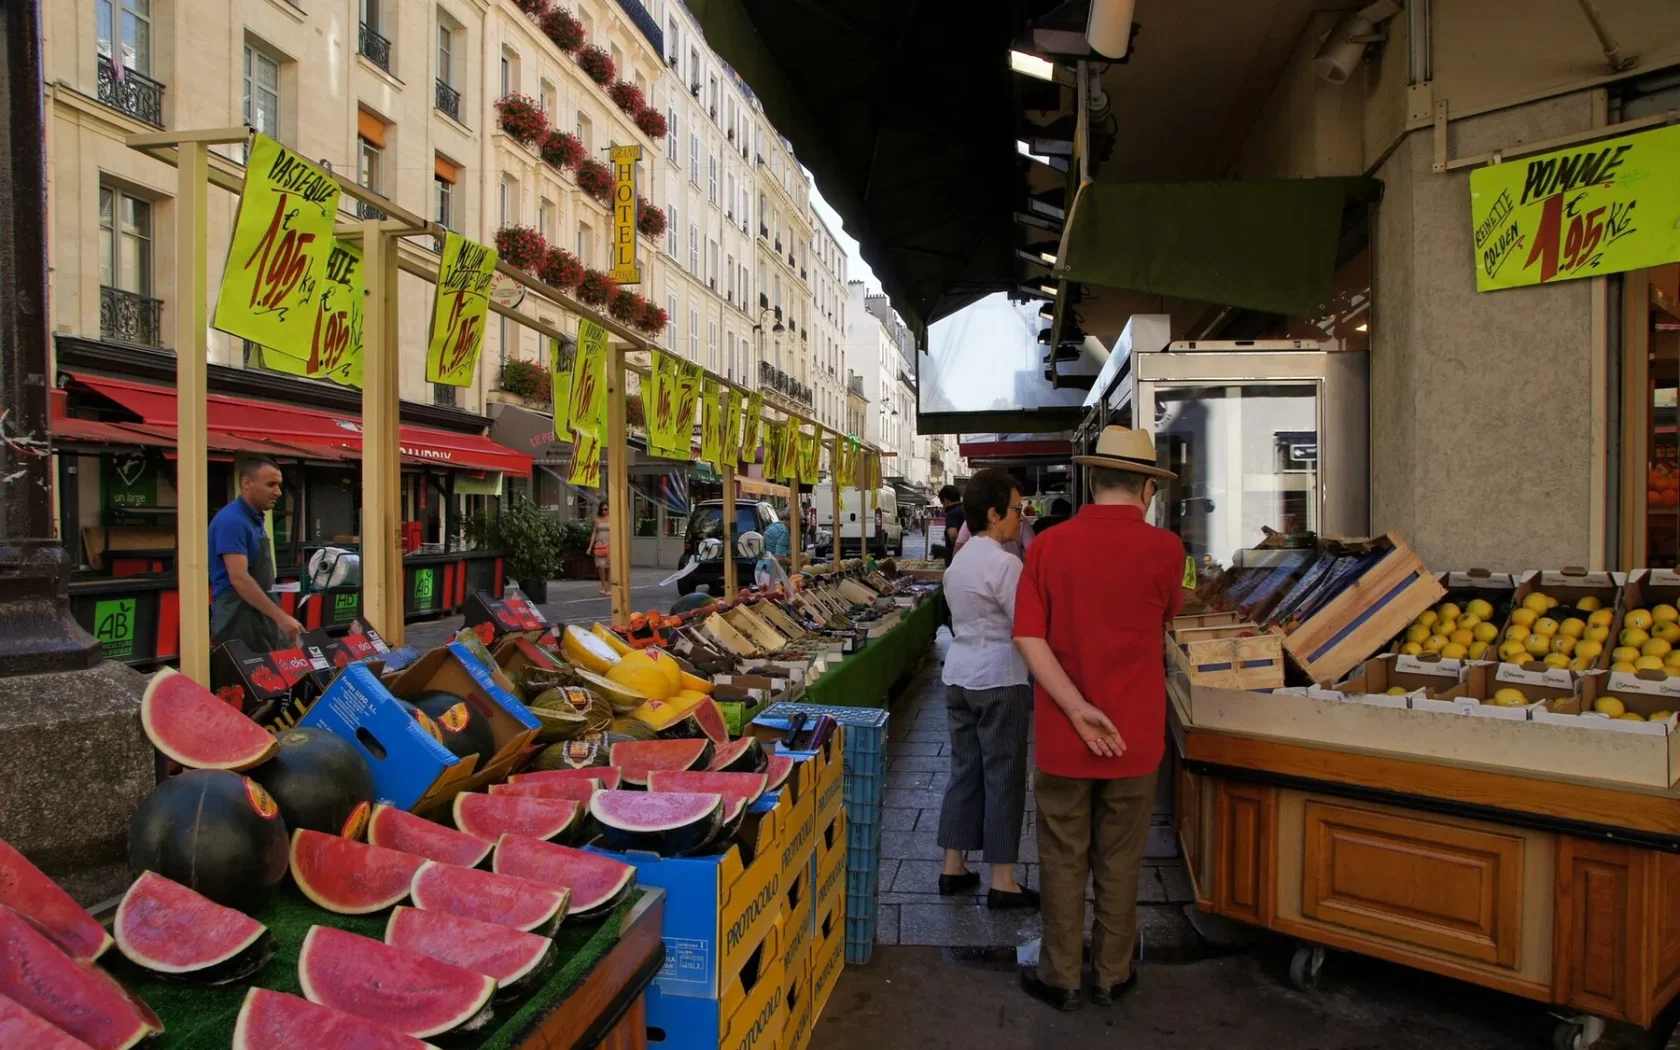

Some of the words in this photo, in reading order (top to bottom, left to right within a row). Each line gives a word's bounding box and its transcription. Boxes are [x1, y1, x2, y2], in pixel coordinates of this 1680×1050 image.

[267, 148, 337, 203] PASTEQUE
[1520, 144, 1633, 206] POMME
[617, 164, 632, 265] HOTEL
[1474, 188, 1514, 245] REINETTE
[326, 246, 360, 285] ATE
[97, 612, 128, 640] AB
[781, 812, 814, 876] PROTOCOLO
[727, 873, 779, 957] PROTOCOLO
[814, 936, 845, 1001] PROTOCOLO
[737, 985, 782, 1050] TOCOLO
